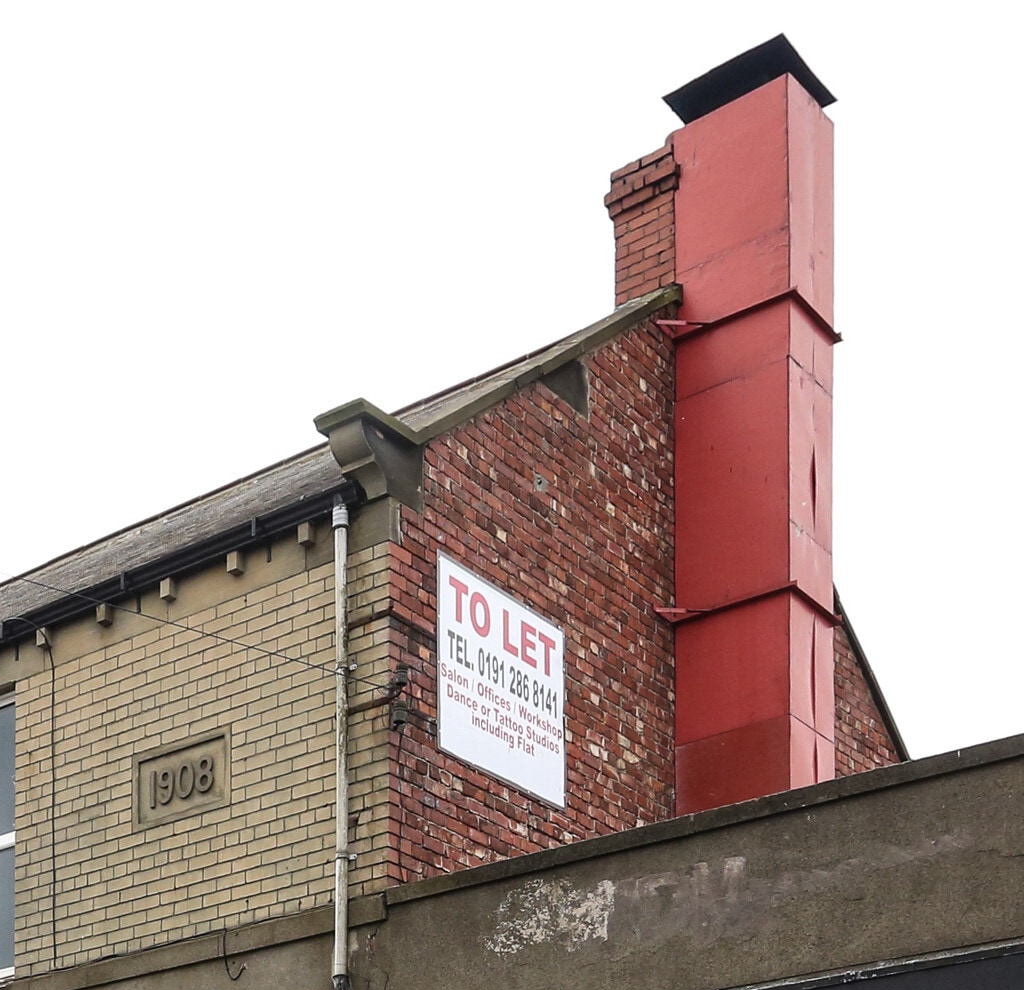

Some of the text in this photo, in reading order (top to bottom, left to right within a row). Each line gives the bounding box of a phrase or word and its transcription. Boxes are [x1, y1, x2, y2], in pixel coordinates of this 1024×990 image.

[449, 574, 556, 677] TO LET
[441, 662, 562, 741] Salon Offices Workshop
[448, 629, 557, 719] TEL. 0191 286 8141
[447, 683, 559, 754] Dance or Tattoo Studios
[472, 711, 535, 756] including Flat
[150, 755, 214, 810] 1908
